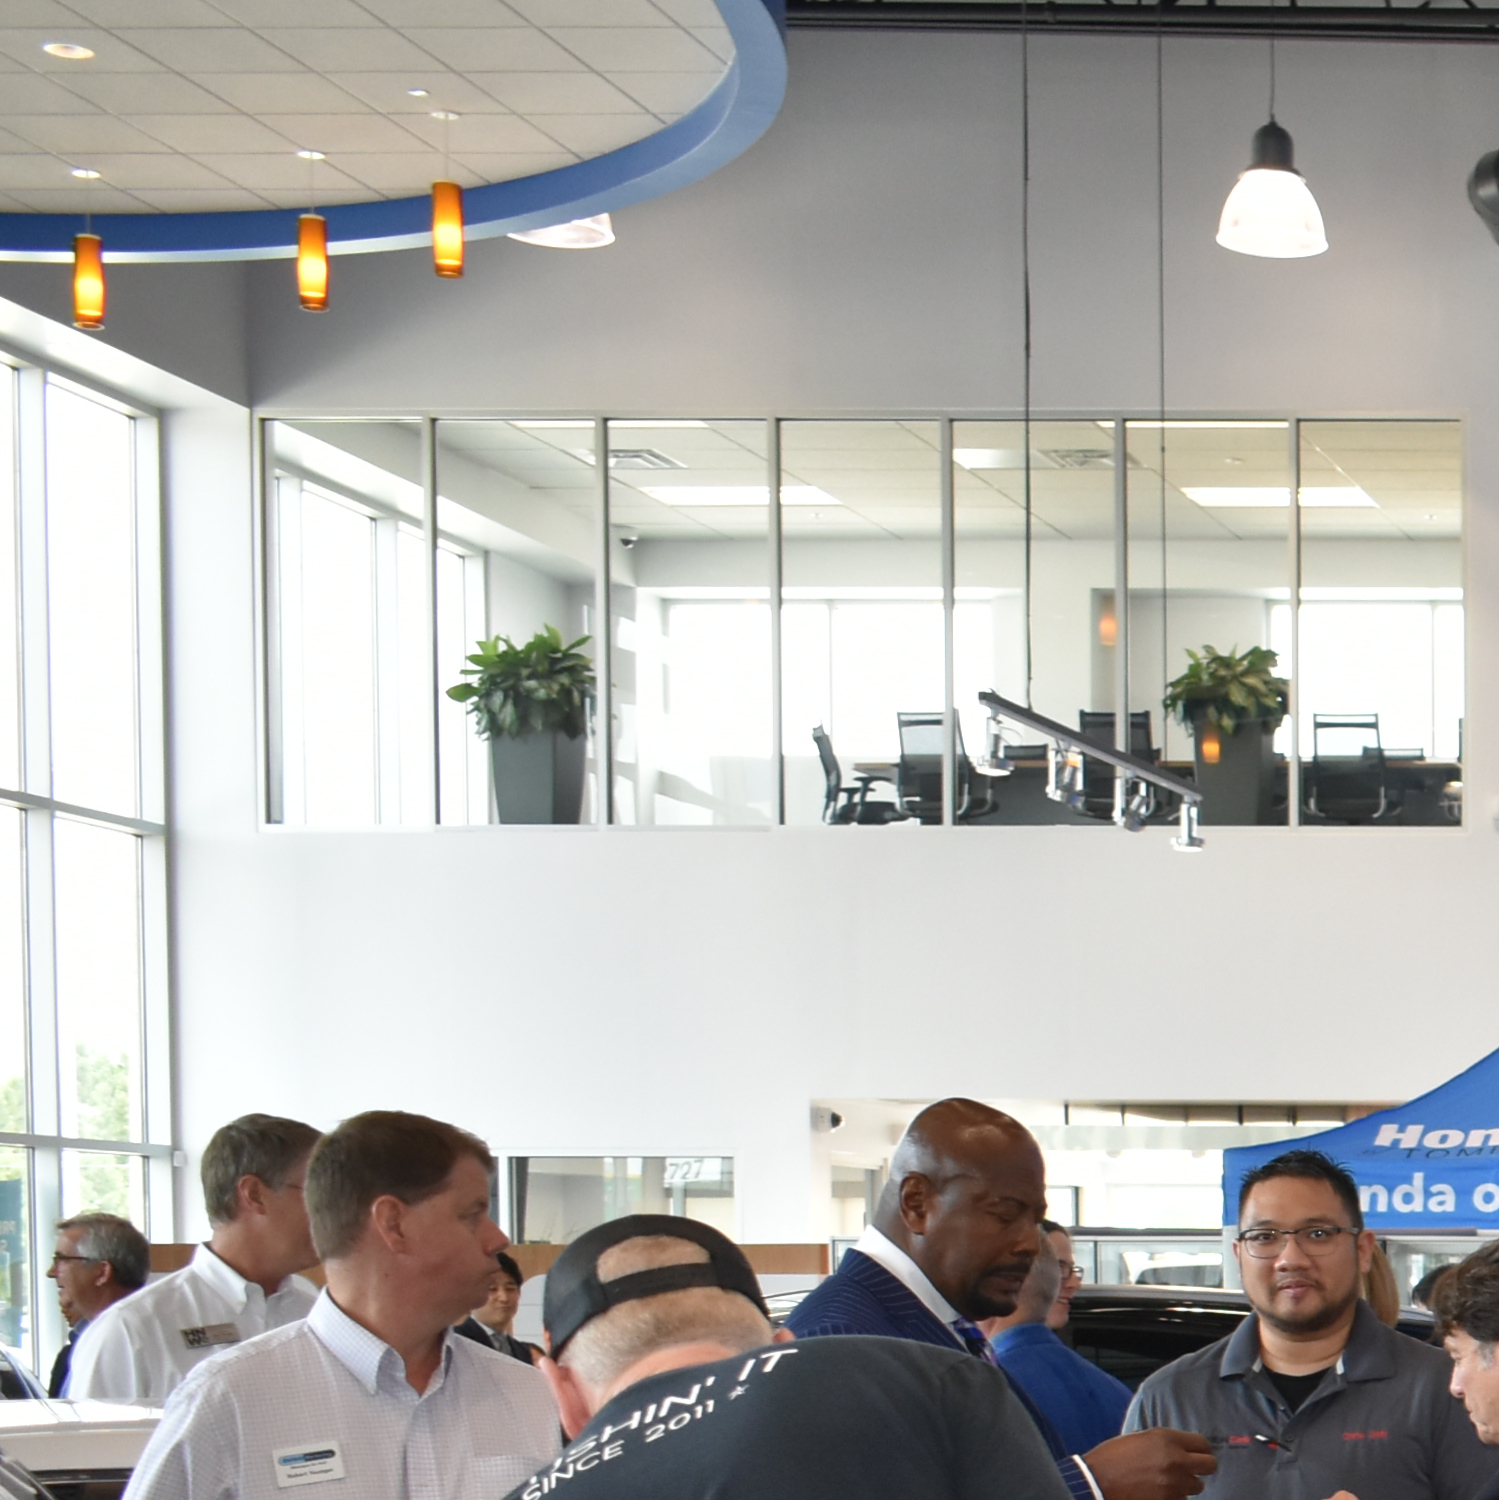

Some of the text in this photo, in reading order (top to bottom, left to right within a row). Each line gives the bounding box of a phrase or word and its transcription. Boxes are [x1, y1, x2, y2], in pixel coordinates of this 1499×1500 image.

[668, 1159, 706, 1180] 727
[1358, 1171, 1456, 1213] nda
[738, 1348, 799, 1382] IT
[644, 1398, 716, 1443] 2011
